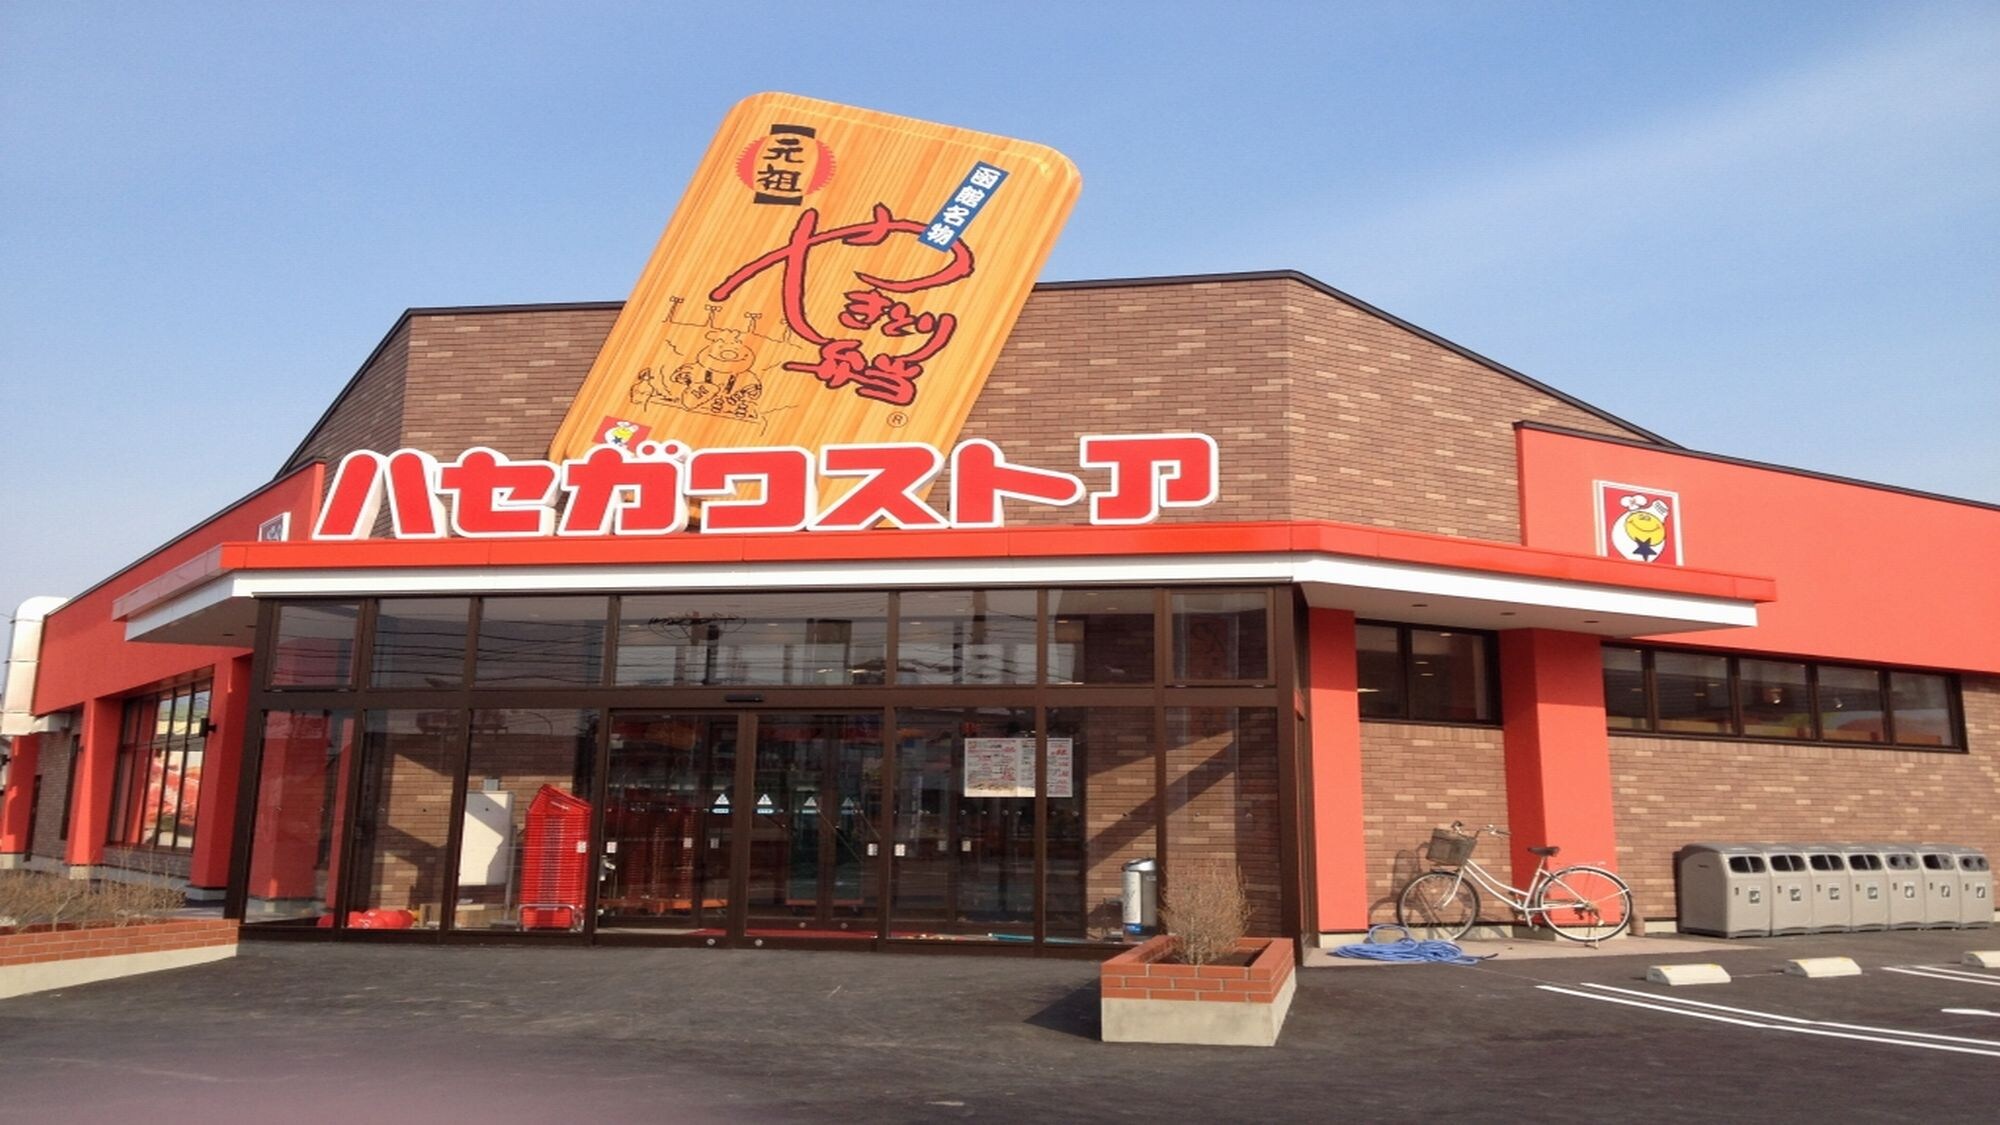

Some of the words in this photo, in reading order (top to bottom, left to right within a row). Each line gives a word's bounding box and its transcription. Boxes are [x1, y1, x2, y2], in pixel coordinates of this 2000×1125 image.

[757, 138, 804, 192] 元祖
[927, 166, 1001, 246] 函館名物
[312, 433, 1219, 540] ハセガワストア
